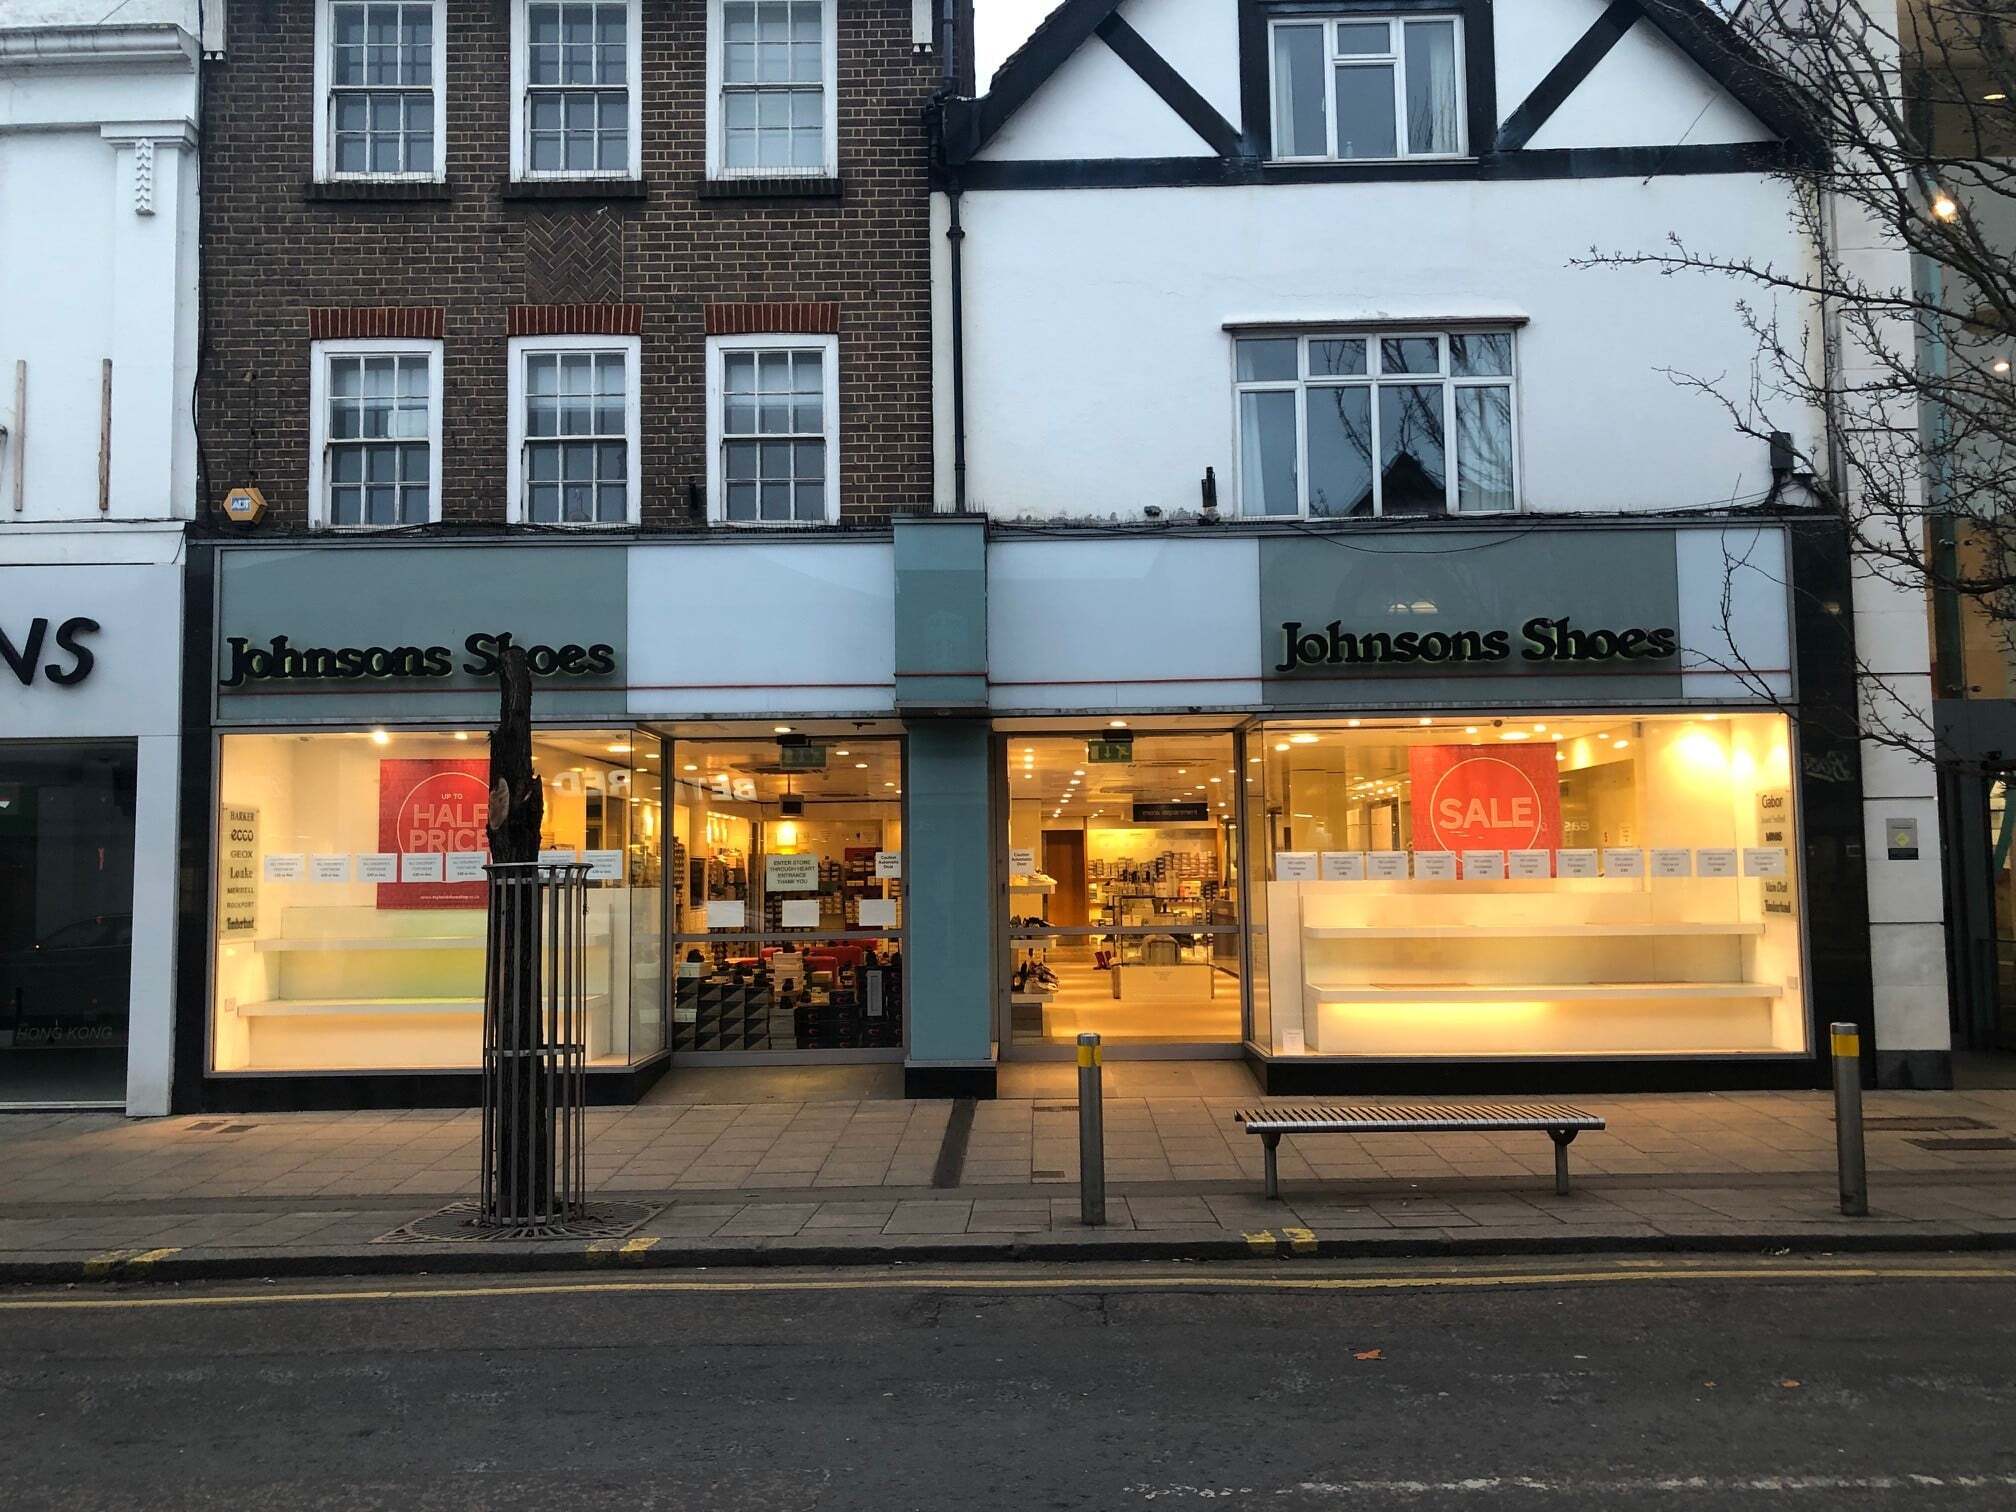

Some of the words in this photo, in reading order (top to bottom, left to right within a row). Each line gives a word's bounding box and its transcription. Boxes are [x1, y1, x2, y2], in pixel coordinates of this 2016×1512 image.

[1275, 620, 1510, 672] Johnsons
[1521, 616, 1675, 661] Shoes
[220, 635, 452, 687] Johnsons
[1439, 797, 1535, 830] SALE
[1761, 794, 1784, 808] Gabor
[413, 803, 489, 828] HALF
[231, 829, 254, 842] ecco
[409, 829, 489, 854] PRICE
[230, 850, 254, 859] GEOX
[16, 1026, 64, 1041] HONG
[66, 1025, 113, 1041] KONG
